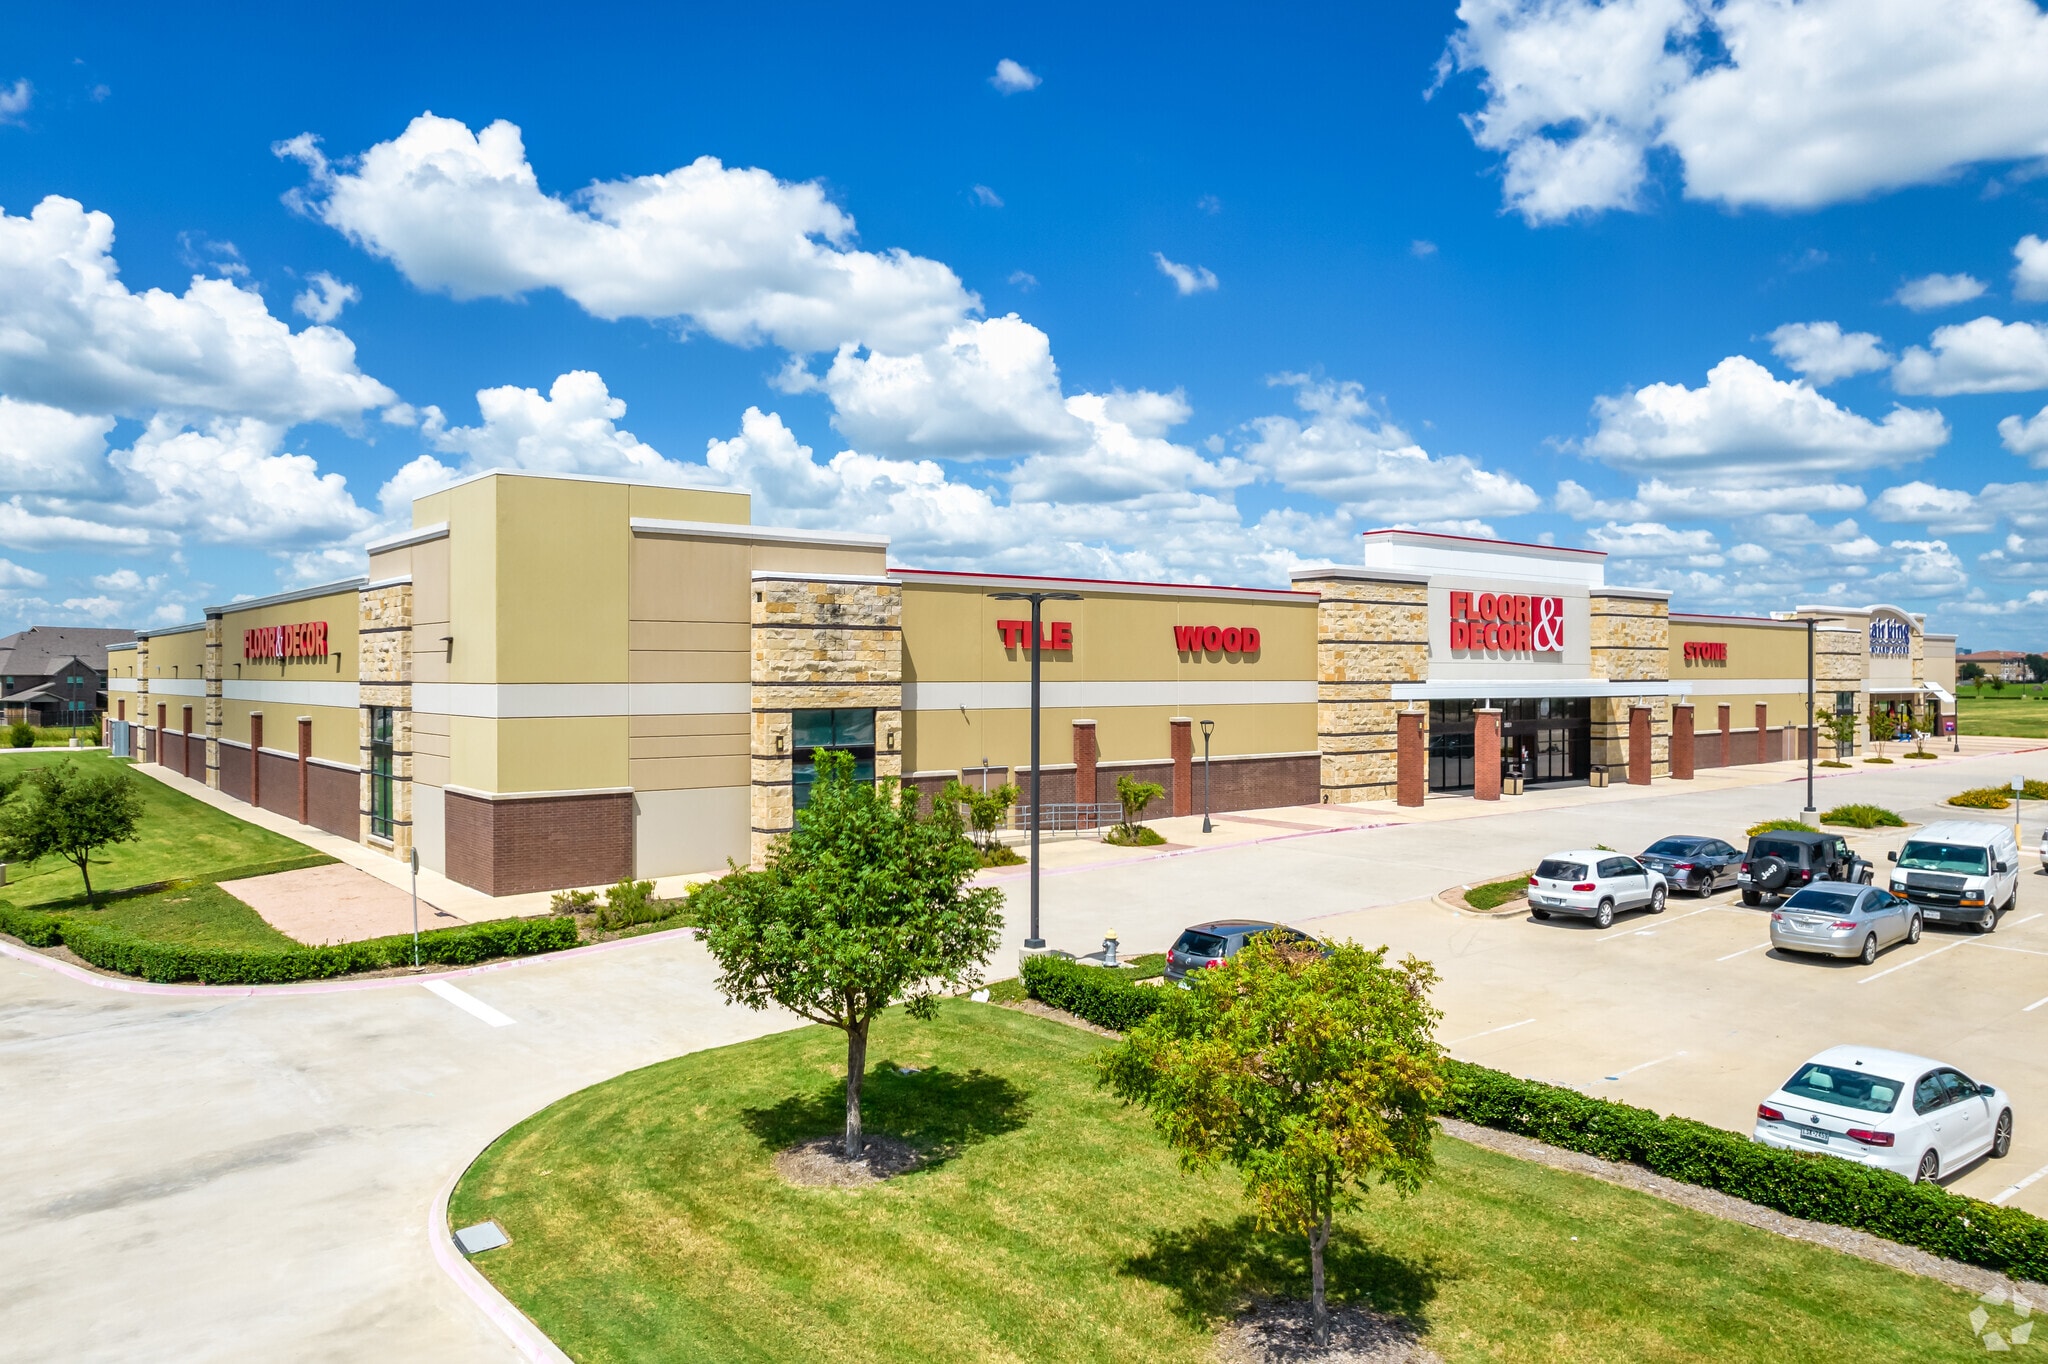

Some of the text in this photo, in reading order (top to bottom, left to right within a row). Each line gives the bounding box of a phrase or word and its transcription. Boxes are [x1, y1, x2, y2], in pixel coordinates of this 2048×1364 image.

[1450, 591, 1530, 622] FLOOR
[244, 627, 276, 658] FLOOR
[284, 621, 328, 657] DECOR
[997, 619, 1072, 650] TILE
[1173, 625, 1260, 652] WOOD
[1450, 621, 1530, 651] DECOR
[1887, 618, 1910, 645] king
[1684, 641, 1727, 661] STONE
[1761, 864, 1778, 880] Jeep
